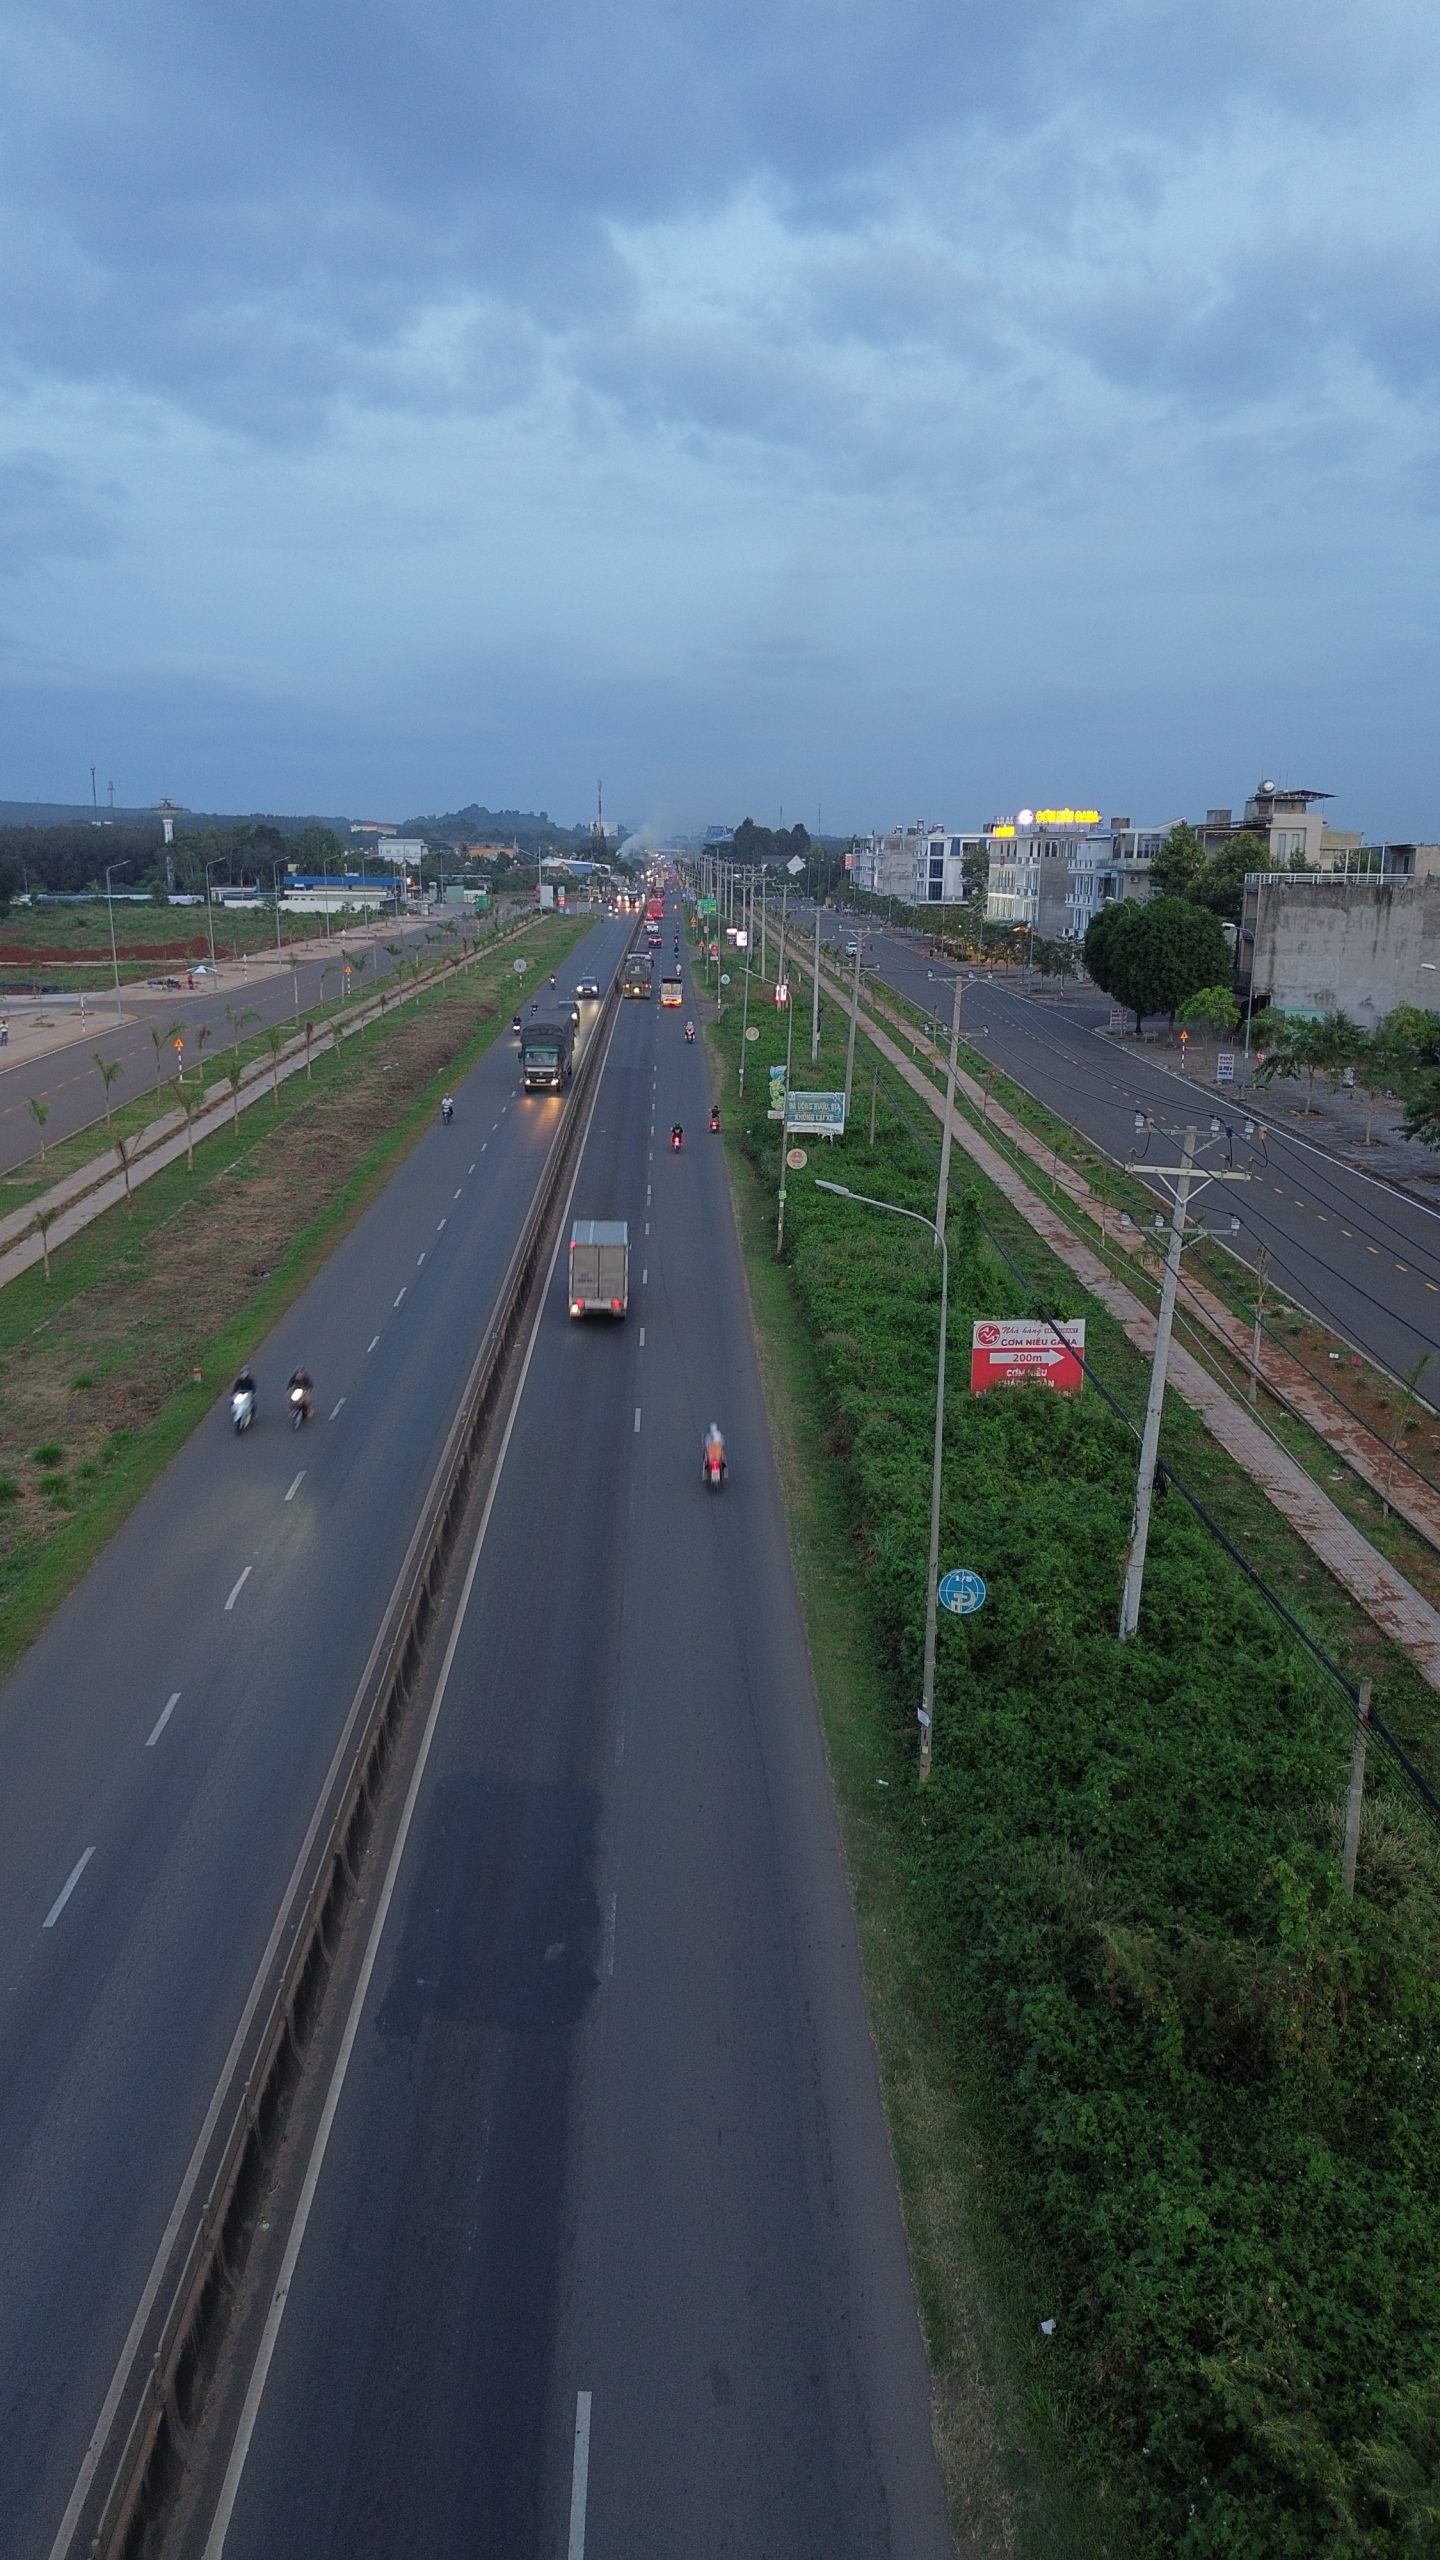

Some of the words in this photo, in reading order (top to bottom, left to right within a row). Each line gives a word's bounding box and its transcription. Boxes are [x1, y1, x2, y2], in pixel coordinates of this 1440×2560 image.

[1001, 1338, 1023, 1346] CƠM
[1025, 1337, 1048, 1346] NIÊU
[1013, 1354, 1042, 1362] 200m
